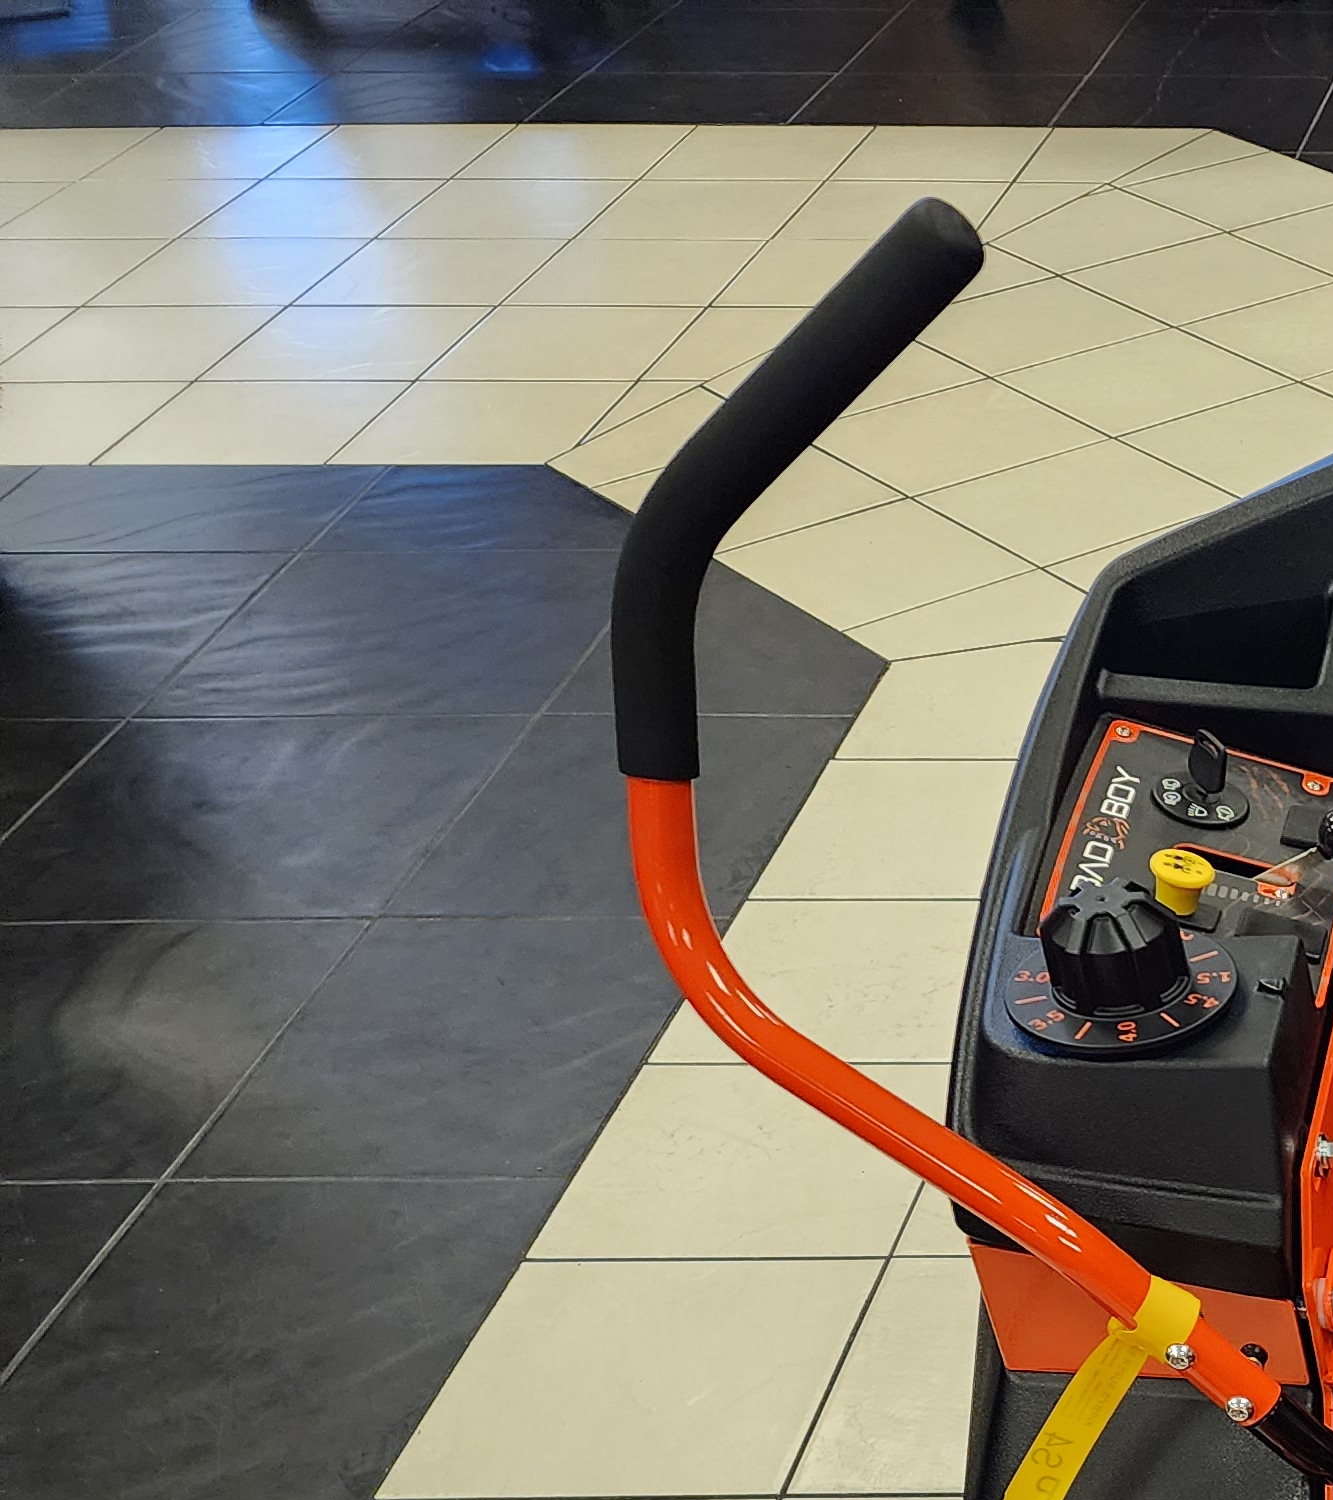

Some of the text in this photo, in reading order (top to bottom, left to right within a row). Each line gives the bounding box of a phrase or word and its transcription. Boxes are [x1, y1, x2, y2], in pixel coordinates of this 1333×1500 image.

[1100, 765, 1141, 819] BOY
[1014, 969, 1050, 984] 3.0
[1196, 971, 1232, 984] 1.5
[1184, 993, 1220, 1009] 4.5
[1028, 1009, 1065, 1031] 3.5
[1117, 1021, 1138, 1043] 4.0
